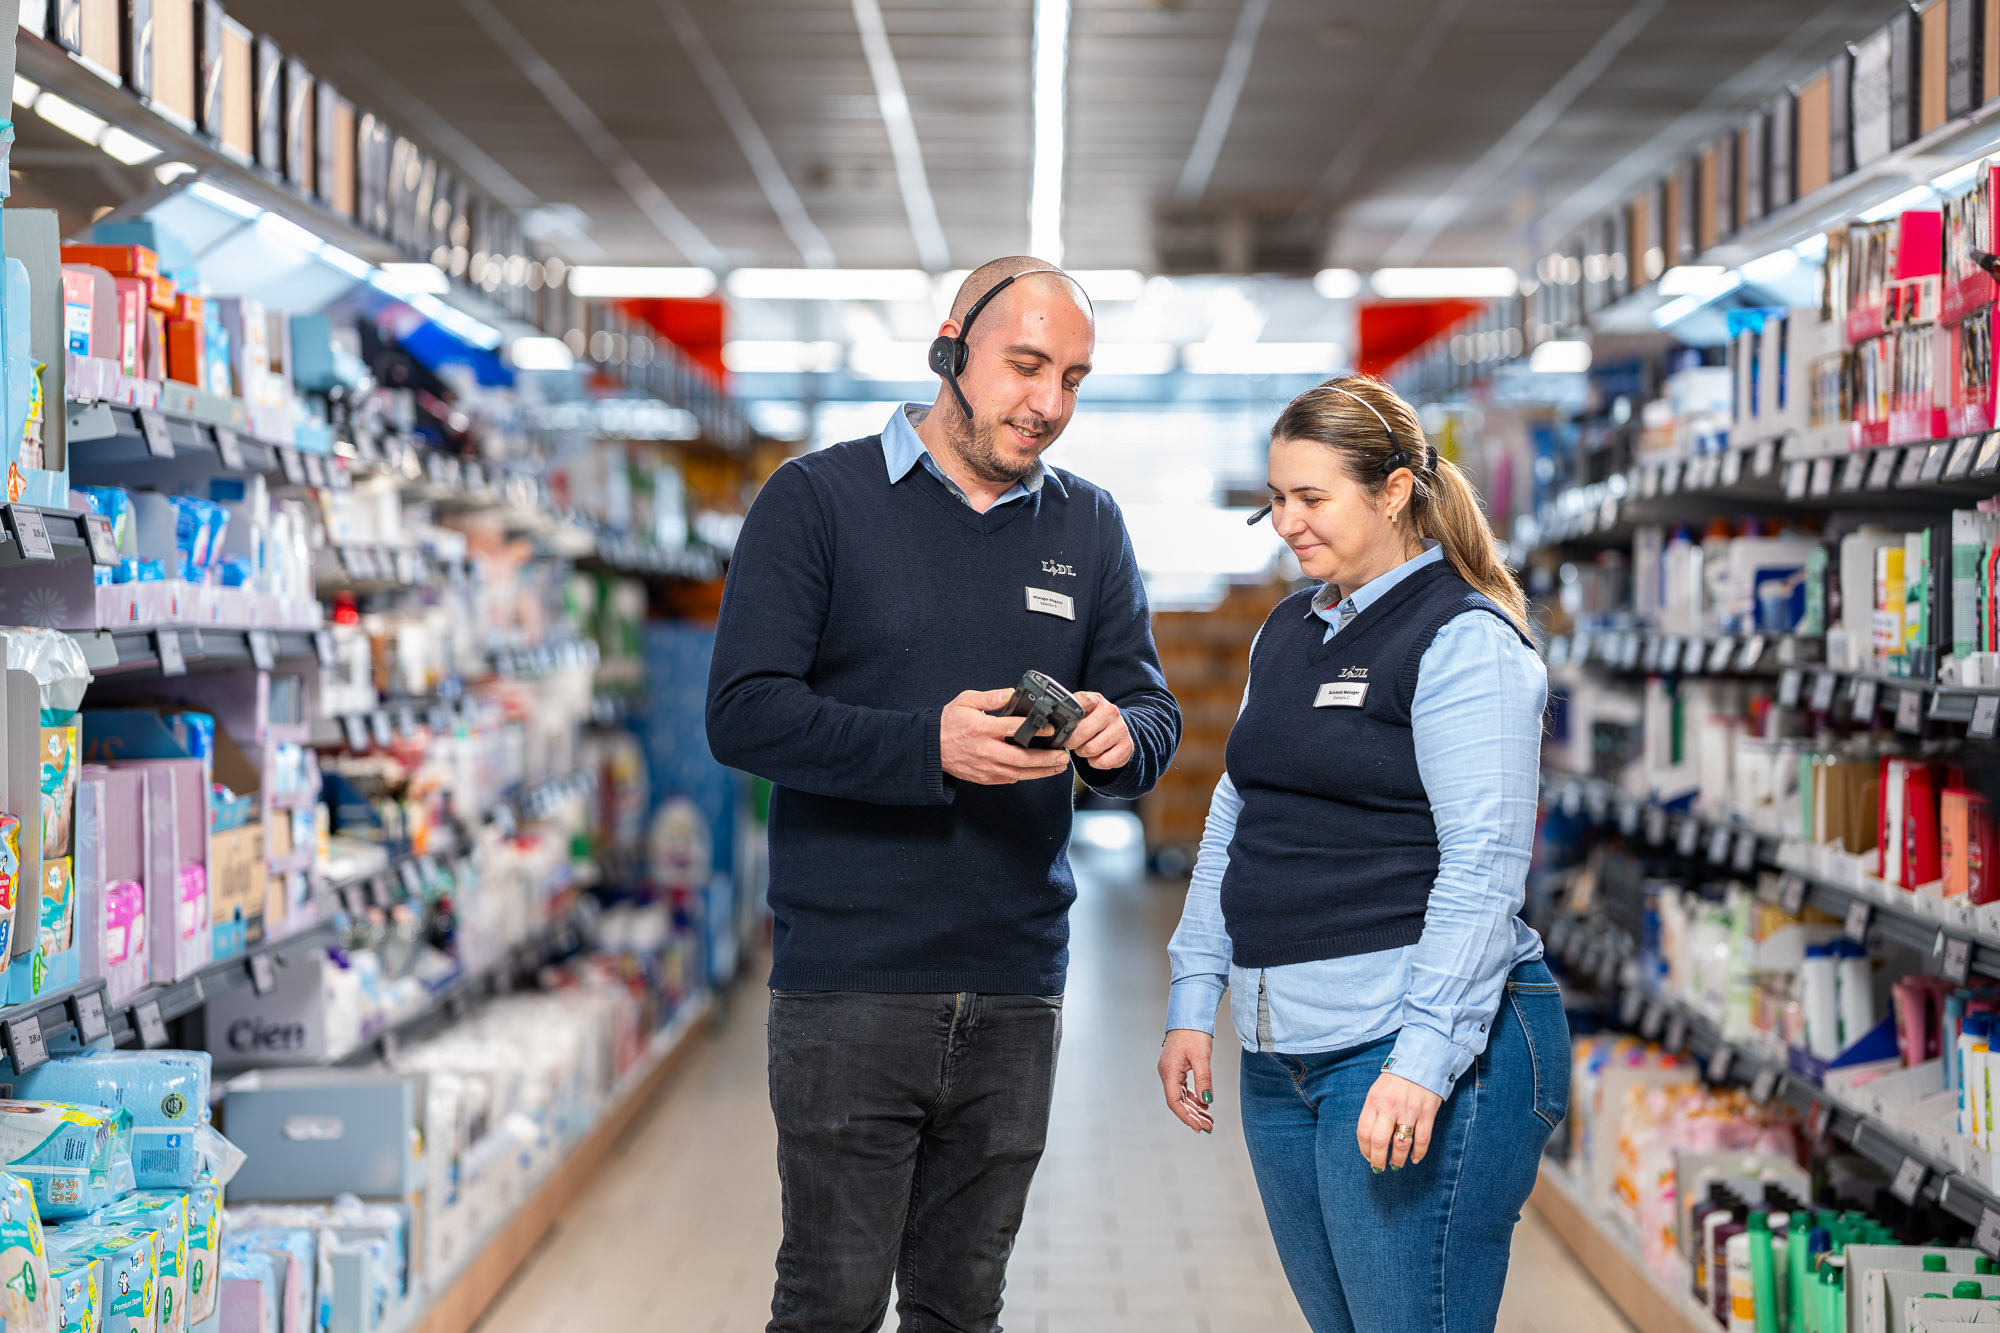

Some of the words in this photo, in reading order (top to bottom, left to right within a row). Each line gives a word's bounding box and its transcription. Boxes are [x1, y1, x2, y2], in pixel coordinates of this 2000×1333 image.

[0, 921, 7, 941] 5
[34, 957, 40, 977] 2
[113, 1300, 131, 1312] Premium
[164, 1290, 170, 1309] 6
